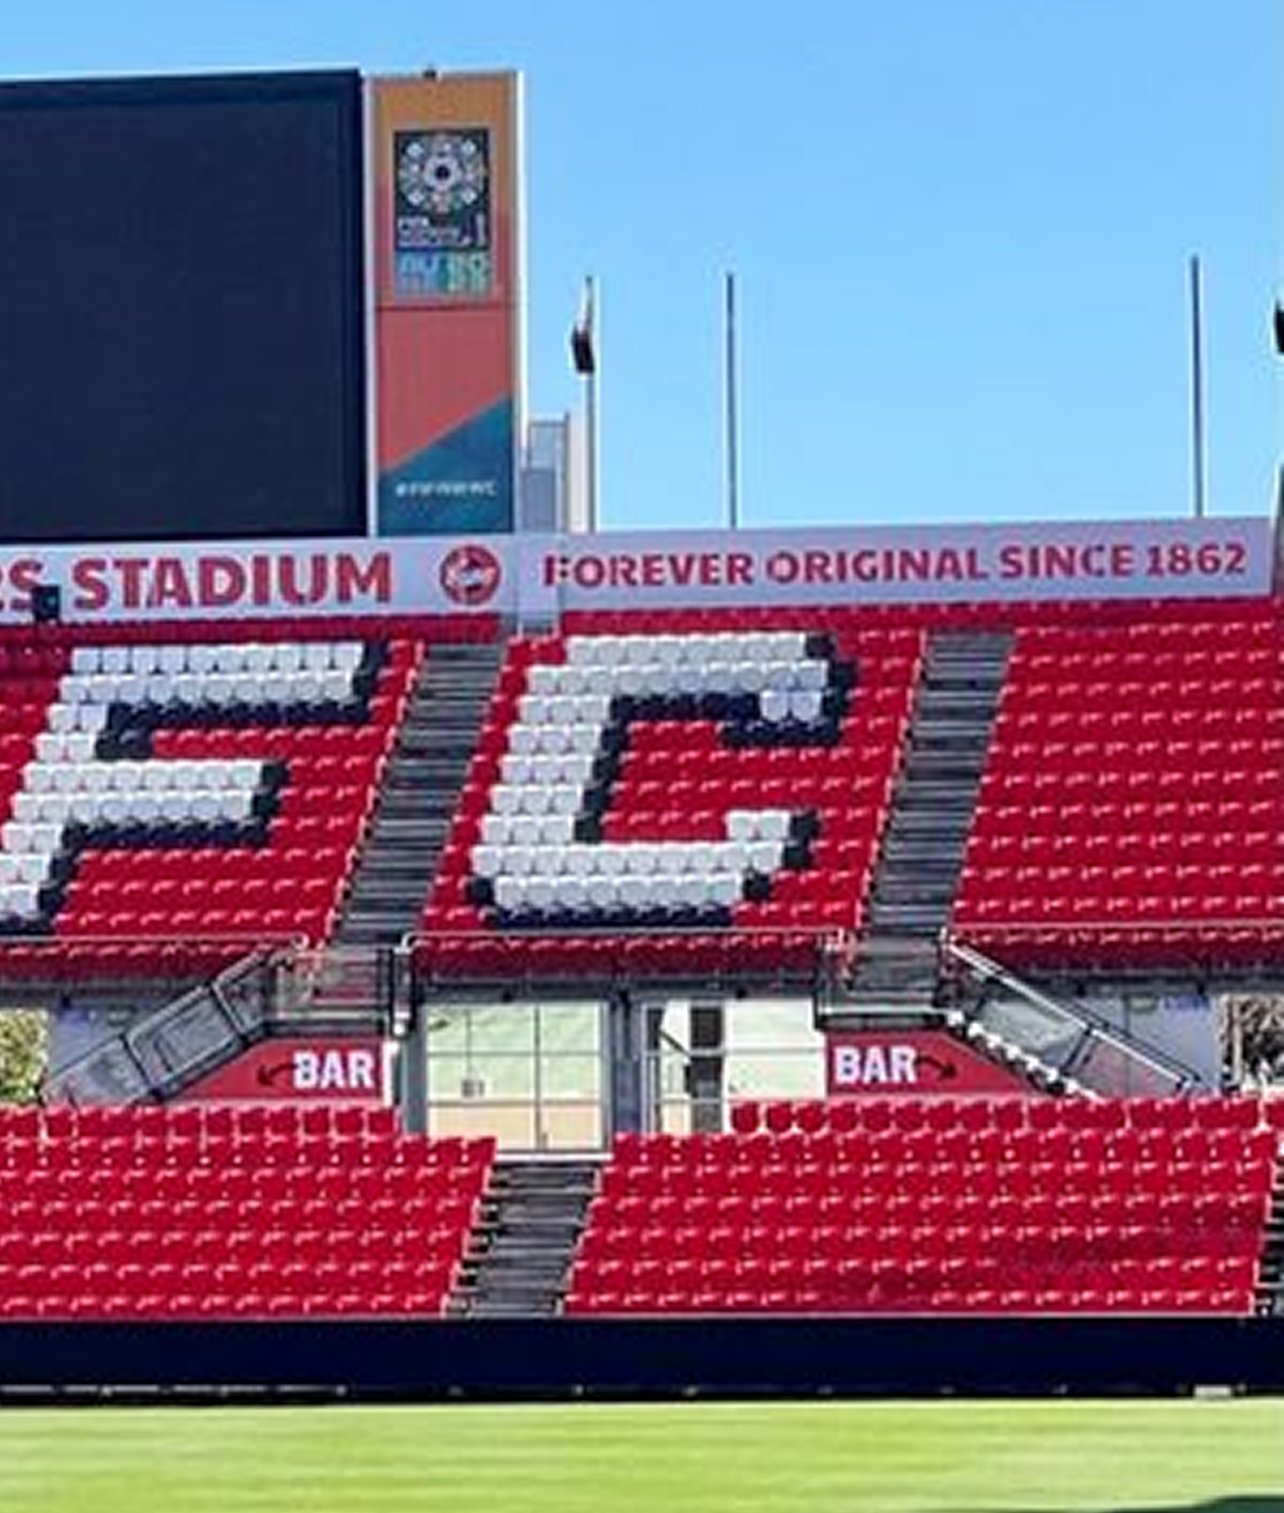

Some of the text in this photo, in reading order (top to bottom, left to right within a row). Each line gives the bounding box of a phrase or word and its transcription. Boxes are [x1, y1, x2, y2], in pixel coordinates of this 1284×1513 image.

[71, 550, 394, 611] STADIUM
[543, 540, 1247, 588] FOREVER ORIGINAL SINCE 1862
[292, 1050, 375, 1090] BAR
[833, 1045, 916, 1085] BAR
